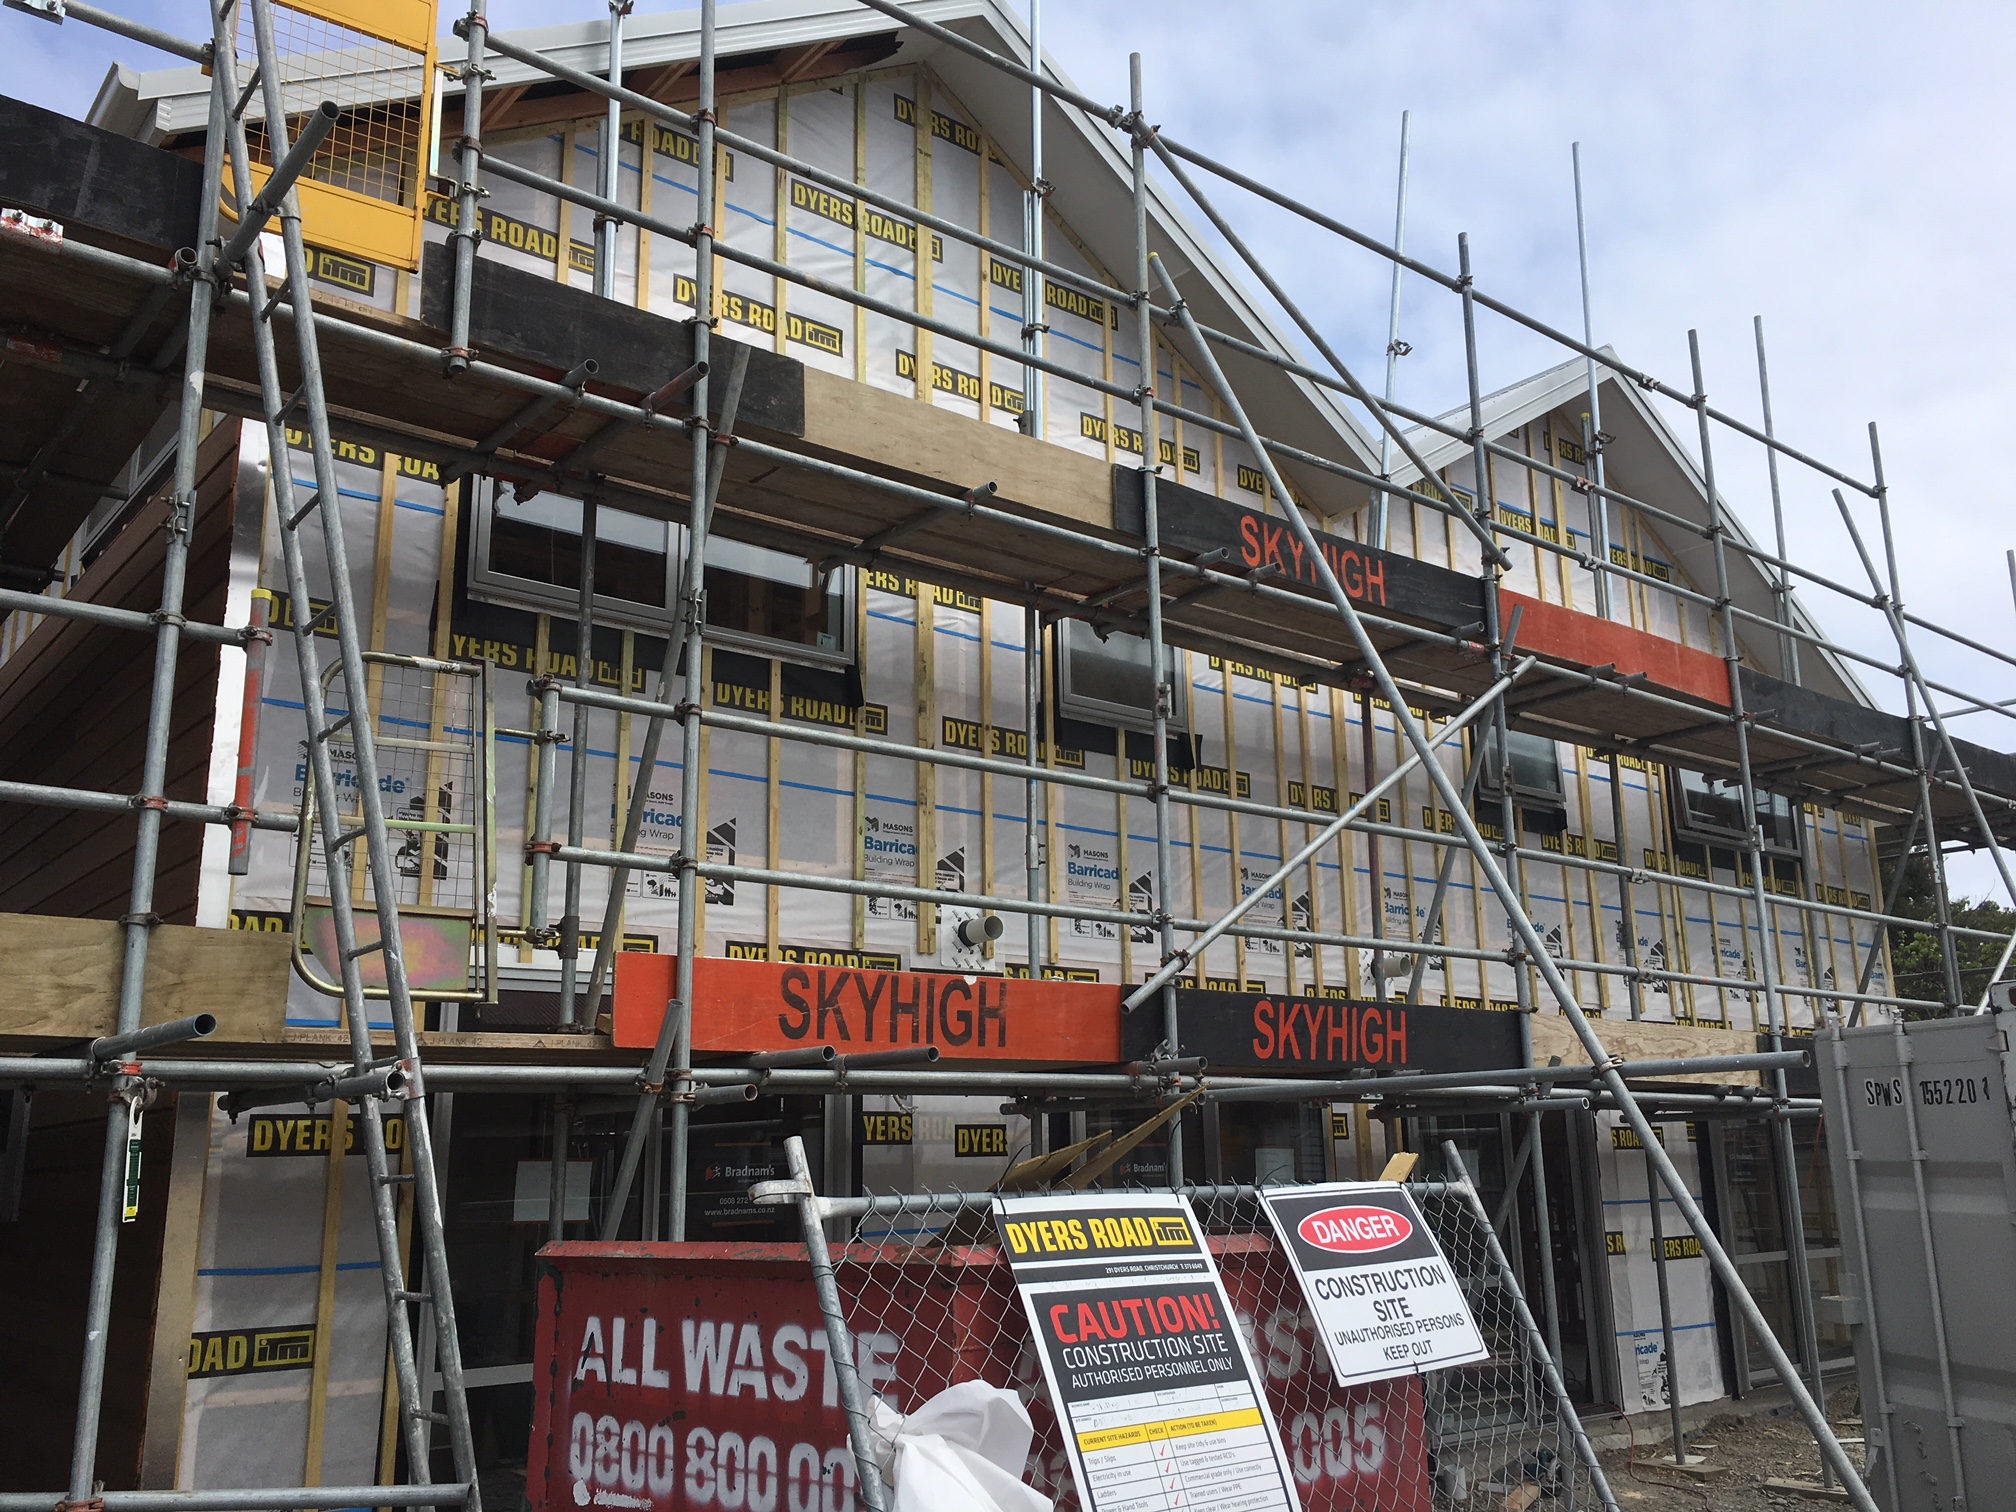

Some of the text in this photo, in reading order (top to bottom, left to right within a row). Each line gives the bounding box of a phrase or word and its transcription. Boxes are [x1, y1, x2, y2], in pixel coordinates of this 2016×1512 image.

[897, 99, 950, 138] DYRS
[795, 183, 853, 225] DYERS
[491, 217, 557, 258] ROAD
[993, 262, 1087, 315] DYE ROAD
[678, 280, 742, 321] DYRS
[899, 353, 1002, 406] DYRS ROD
[1501, 510, 1556, 542] DYERS OAD
[1290, 785, 1331, 807] DYRS
[649, 829, 674, 840] Wrap
[883, 822, 913, 833] MASONS
[865, 836, 917, 855] Barrica
[1084, 849, 1109, 858] MASONS
[895, 857, 915, 867] Wrap
[1068, 862, 1118, 880] Barricad
[1068, 878, 1110, 890] Building Wrap
[778, 966, 1007, 1047] SKYHIGH
[301, 1034, 332, 1042] PLANK
[439, 1037, 466, 1045] PLANK
[1253, 1000, 1407, 1064] SKYHIGH
[1866, 1079, 1902, 1106] SPWS
[863, 1115, 912, 1142] YERS
[1620, 1128, 1642, 1146] ROA
[725, 1165, 775, 1177] Bradnam's
[1134, 1162, 1166, 1172] Bradnam'
[704, 1207, 775, 1216] www.bradnams.co.nz
[1005, 1219, 1089, 1254] DYERS
[1088, 1217, 1154, 1249] ROAD
[1311, 1215, 1400, 1244] DANGER
[1683, 1238, 1701, 1255] ROA
[1315, 1264, 1447, 1300] CONSTRUCTION
[1050, 1293, 1221, 1344] CAUTION!
[1373, 1297, 1413, 1322] SITE
[1334, 1313, 1465, 1346] UNAUTHORISED PERSONS
[188, 1335, 248, 1373] OAD
[1062, 1334, 1228, 1369] CONSTRUCTION SITE
[1382, 1340, 1434, 1361] KEEP OUT
[572, 1316, 899, 1411] ALL WASTE
[1072, 1356, 1233, 1388] AUTHORISED PERSONNEL ONLY
[1149, 1427, 1164, 1436] CHECK
[1170, 1424, 1187, 1432] ACTION
[1201, 1420, 1217, 1428] TAKEN)
[1083, 1431, 1141, 1445] CURRENT SITE HAZARDS
[1175, 1443, 1185, 1451] Keep
[1291, 1401, 1389, 1485] 005
[570, 1412, 855, 1512] 0800 800 00
[1088, 1457, 1100, 1465] Trips
[1104, 1455, 1116, 1463] Slips
[1189, 1457, 1204, 1466] tagged
[1210, 1454, 1222, 1462] tested
[1093, 1472, 1116, 1482] Electricity
[1185, 1473, 1210, 1483] Commercial
[1224, 1470, 1232, 1478] only
[1244, 1464, 1262, 1473] correctly
[1097, 1490, 1117, 1499] Ladders
[1190, 1489, 1205, 1498] Trained
[1222, 1485, 1232, 1493] Wear
[1122, 1503, 1134, 1511] Hand
[1205, 1503, 1216, 1511] clear
[1231, 1498, 1247, 1507] hearing
[1248, 1495, 1269, 1505] protection
